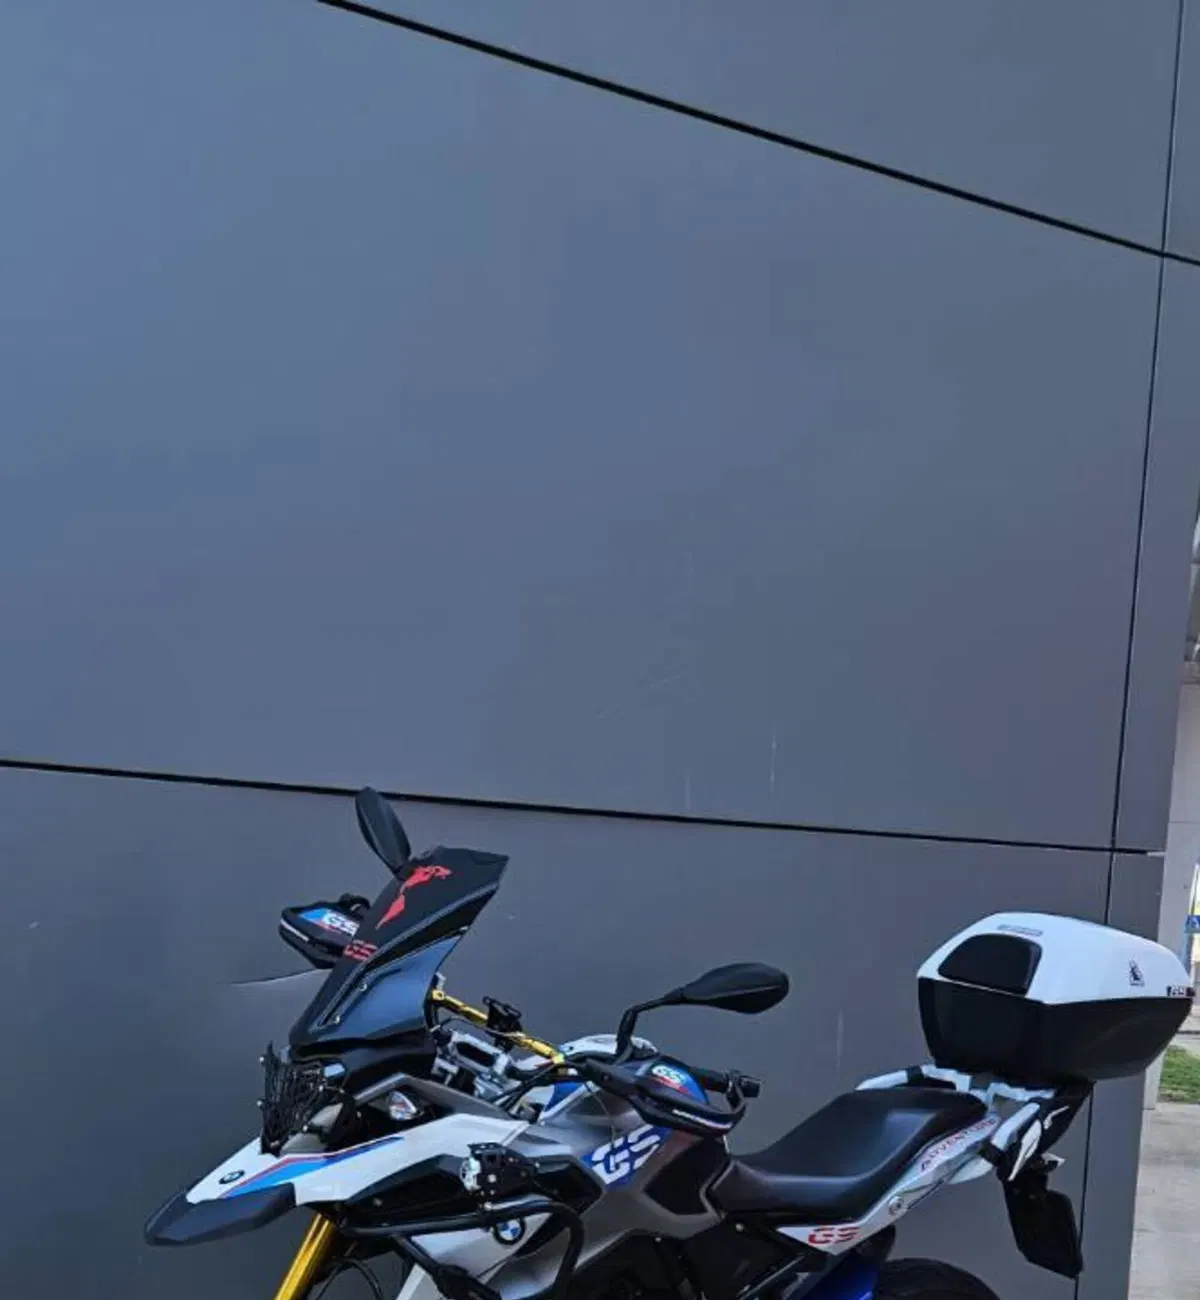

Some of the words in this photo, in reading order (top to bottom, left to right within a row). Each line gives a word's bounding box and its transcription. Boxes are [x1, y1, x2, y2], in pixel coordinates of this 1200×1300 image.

[344, 940, 378, 961] GS
[592, 1125, 659, 1184] GS
[808, 1226, 860, 1244] GS
